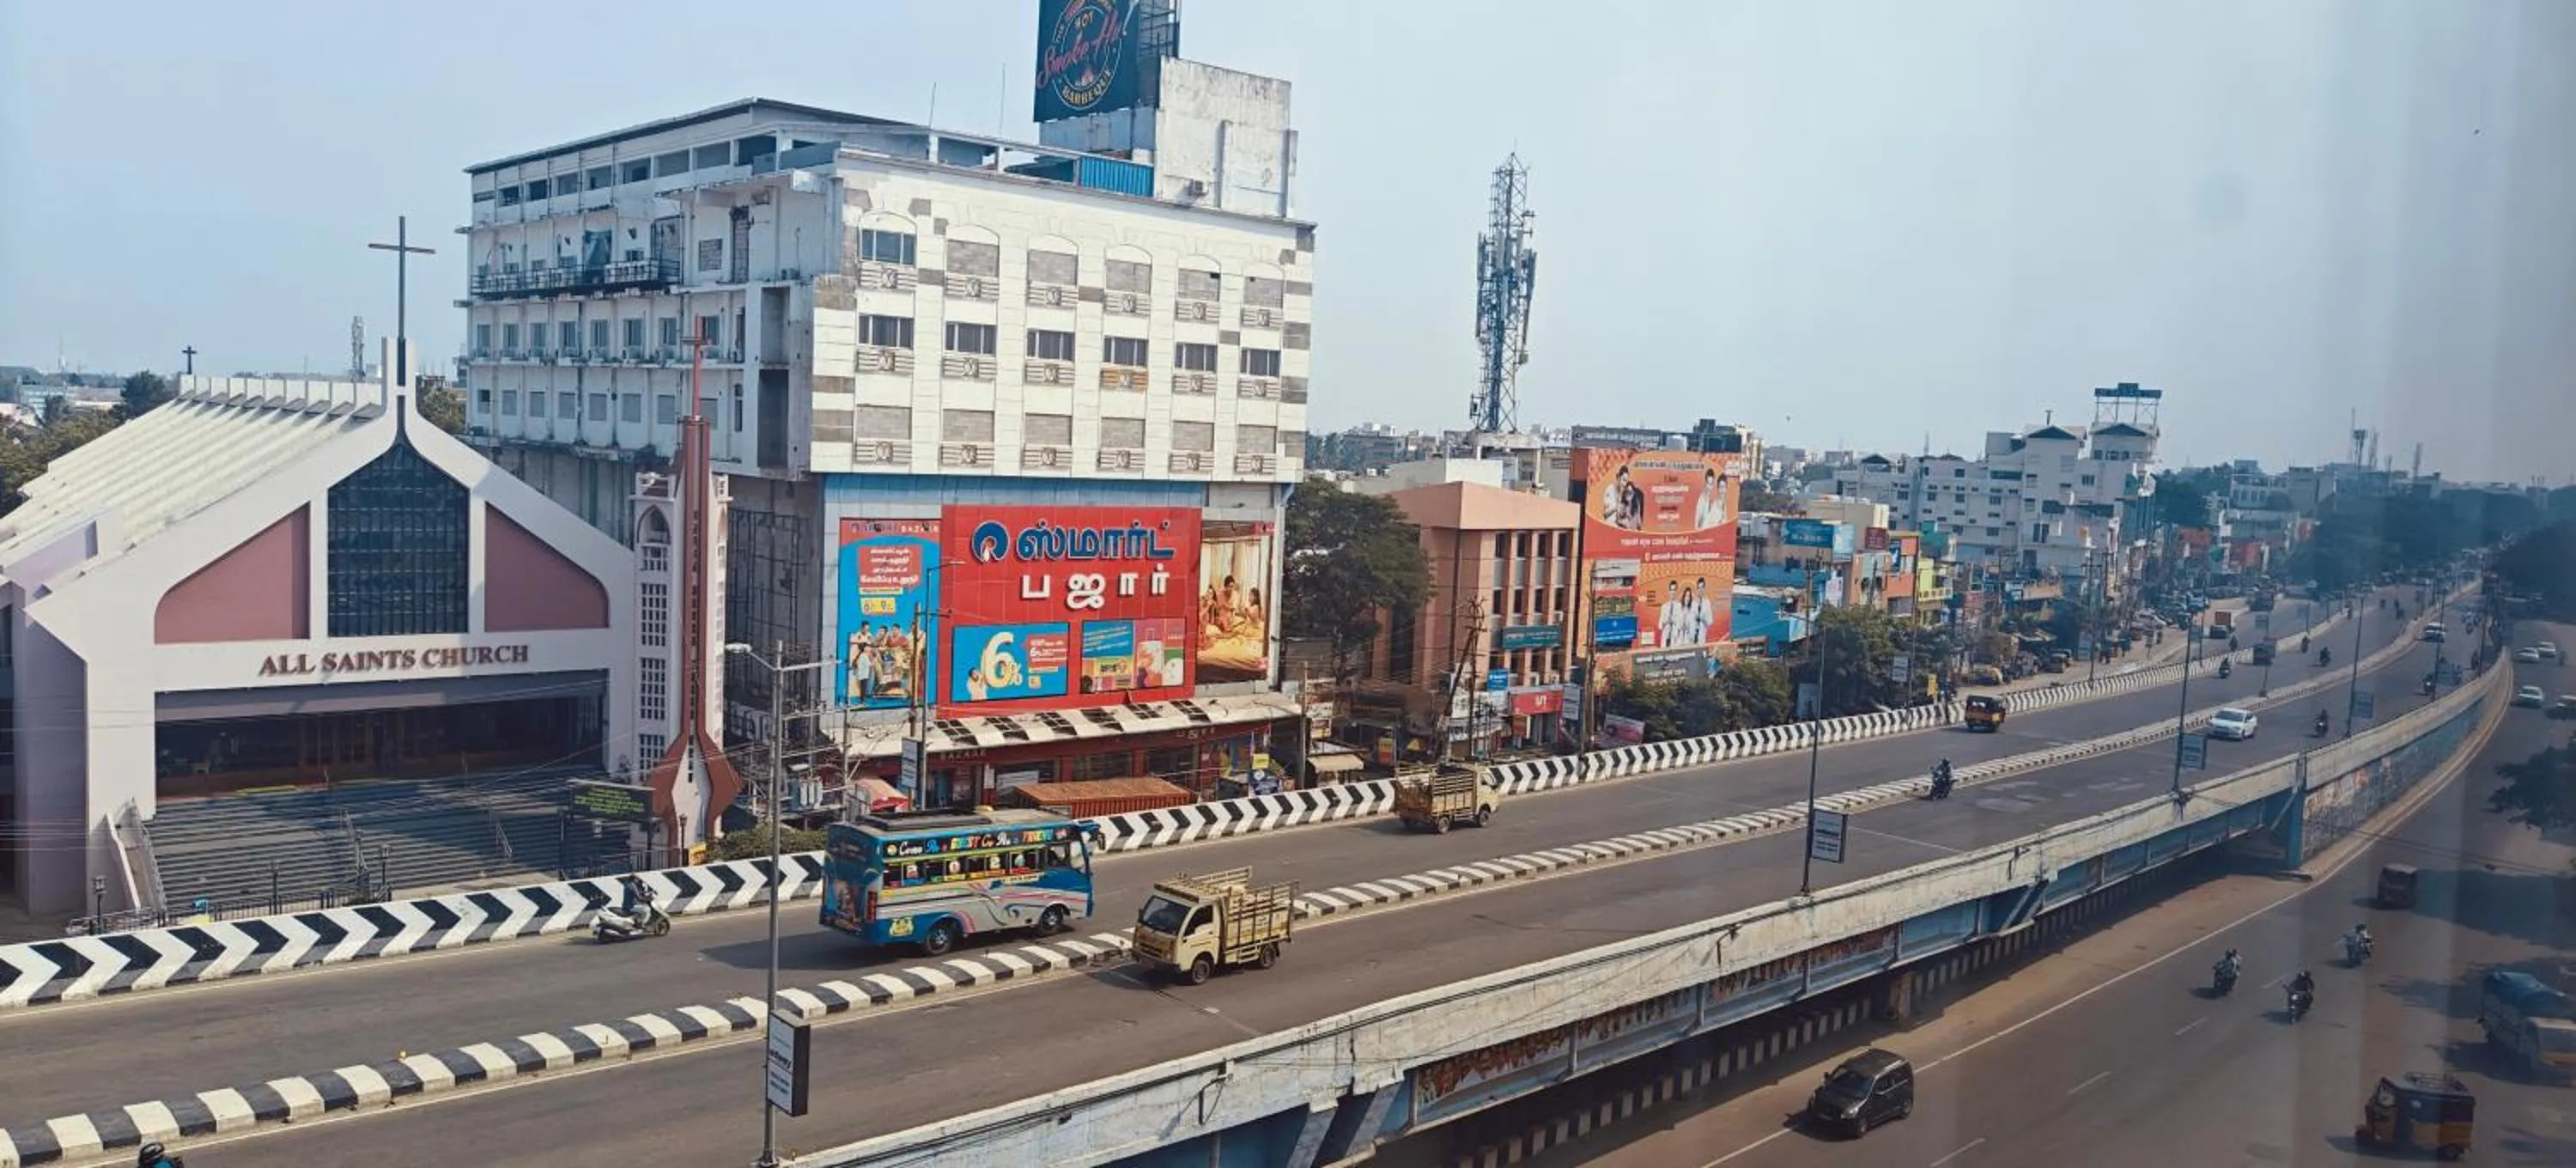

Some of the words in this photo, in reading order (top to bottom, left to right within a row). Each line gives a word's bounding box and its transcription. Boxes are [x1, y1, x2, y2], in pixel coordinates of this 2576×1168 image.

[1017, 519, 1176, 561] ஸ்மார்ட்
[1022, 563, 1170, 609] பஜார்
[259, 654, 315, 677] ALL
[321, 648, 415, 672] SAINTS
[421, 645, 528, 669] CHURCH
